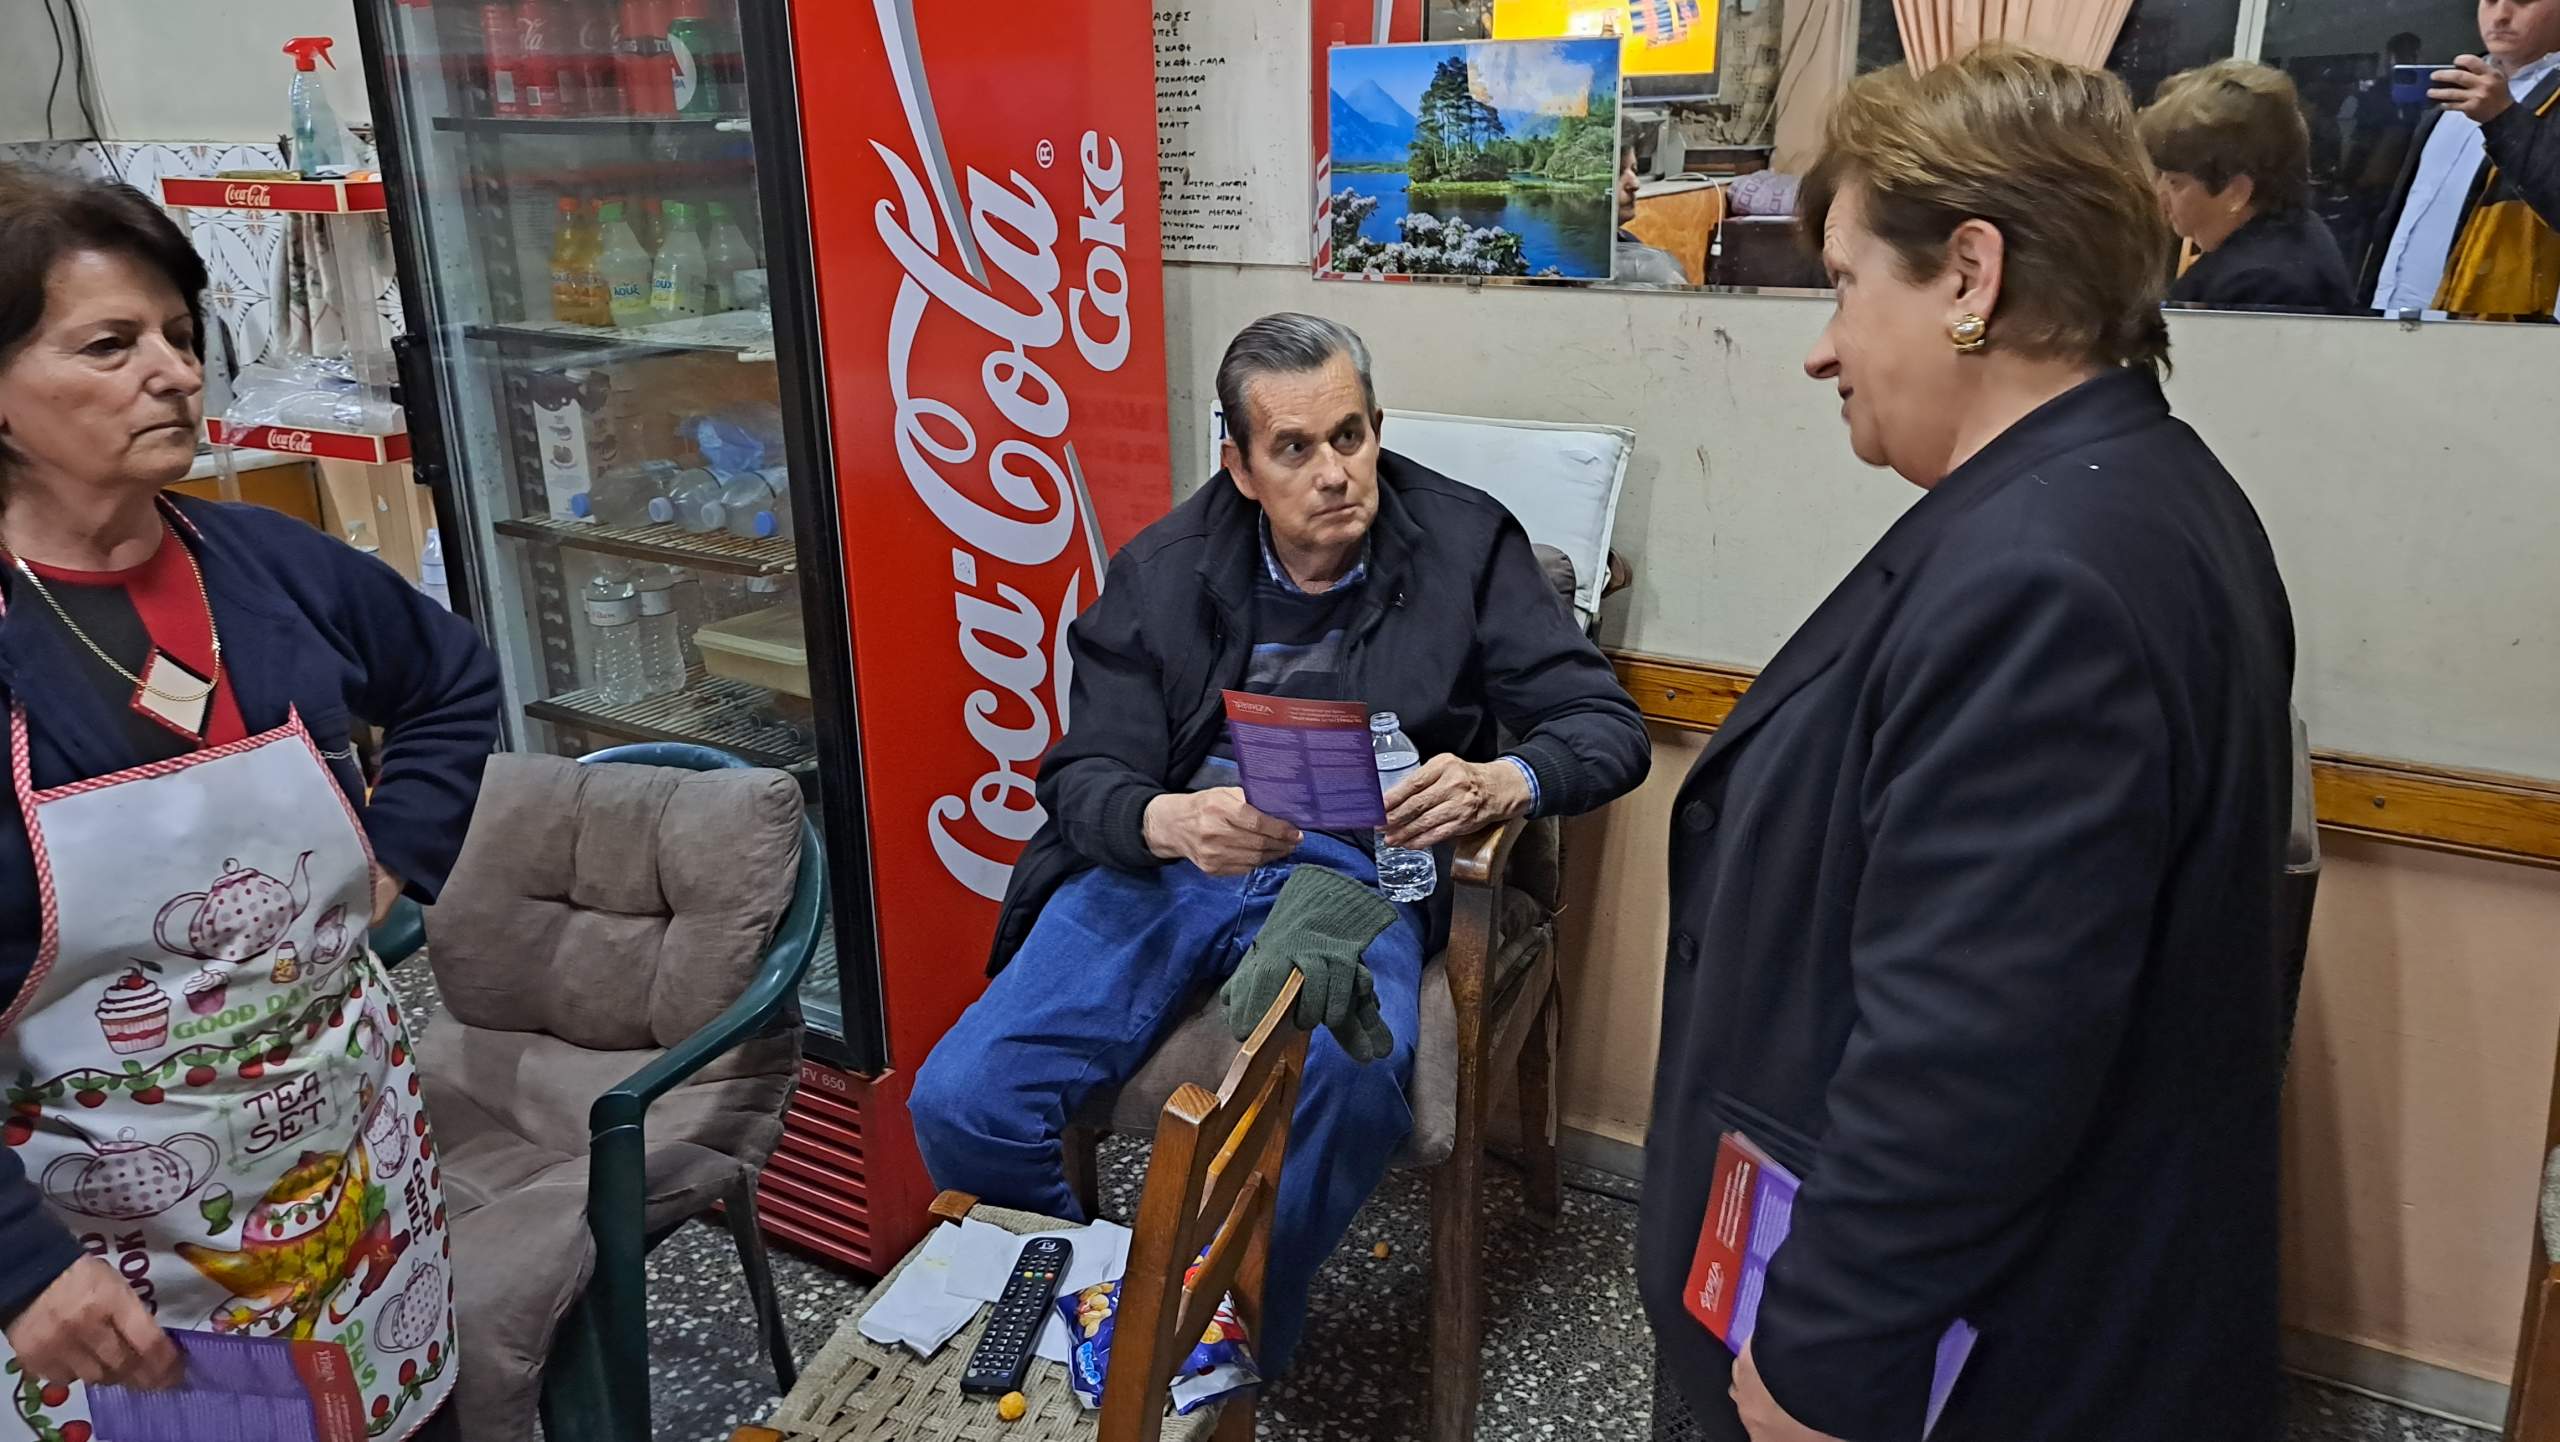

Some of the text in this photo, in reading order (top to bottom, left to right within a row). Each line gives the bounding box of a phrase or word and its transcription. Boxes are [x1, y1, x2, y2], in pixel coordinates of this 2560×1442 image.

[1153, 11, 1191, 21] ΑΦΕΣ
[1155, 74, 1206, 83] ΡΤΟΚΑΛΑΔΑ
[1156, 89, 1198, 98] ΜΟΝΑΔΑ
[1068, 129, 1131, 373] Coke
[867, 138, 1079, 902] Coca-Cola
[172, 1003, 256, 1040] GOOD
[243, 1071, 321, 1120] TEA
[802, 1066, 847, 1092] FV 650
[244, 1097, 327, 1154] SET
[403, 1177, 423, 1246] WILL
[413, 1157, 433, 1237] GOOD
